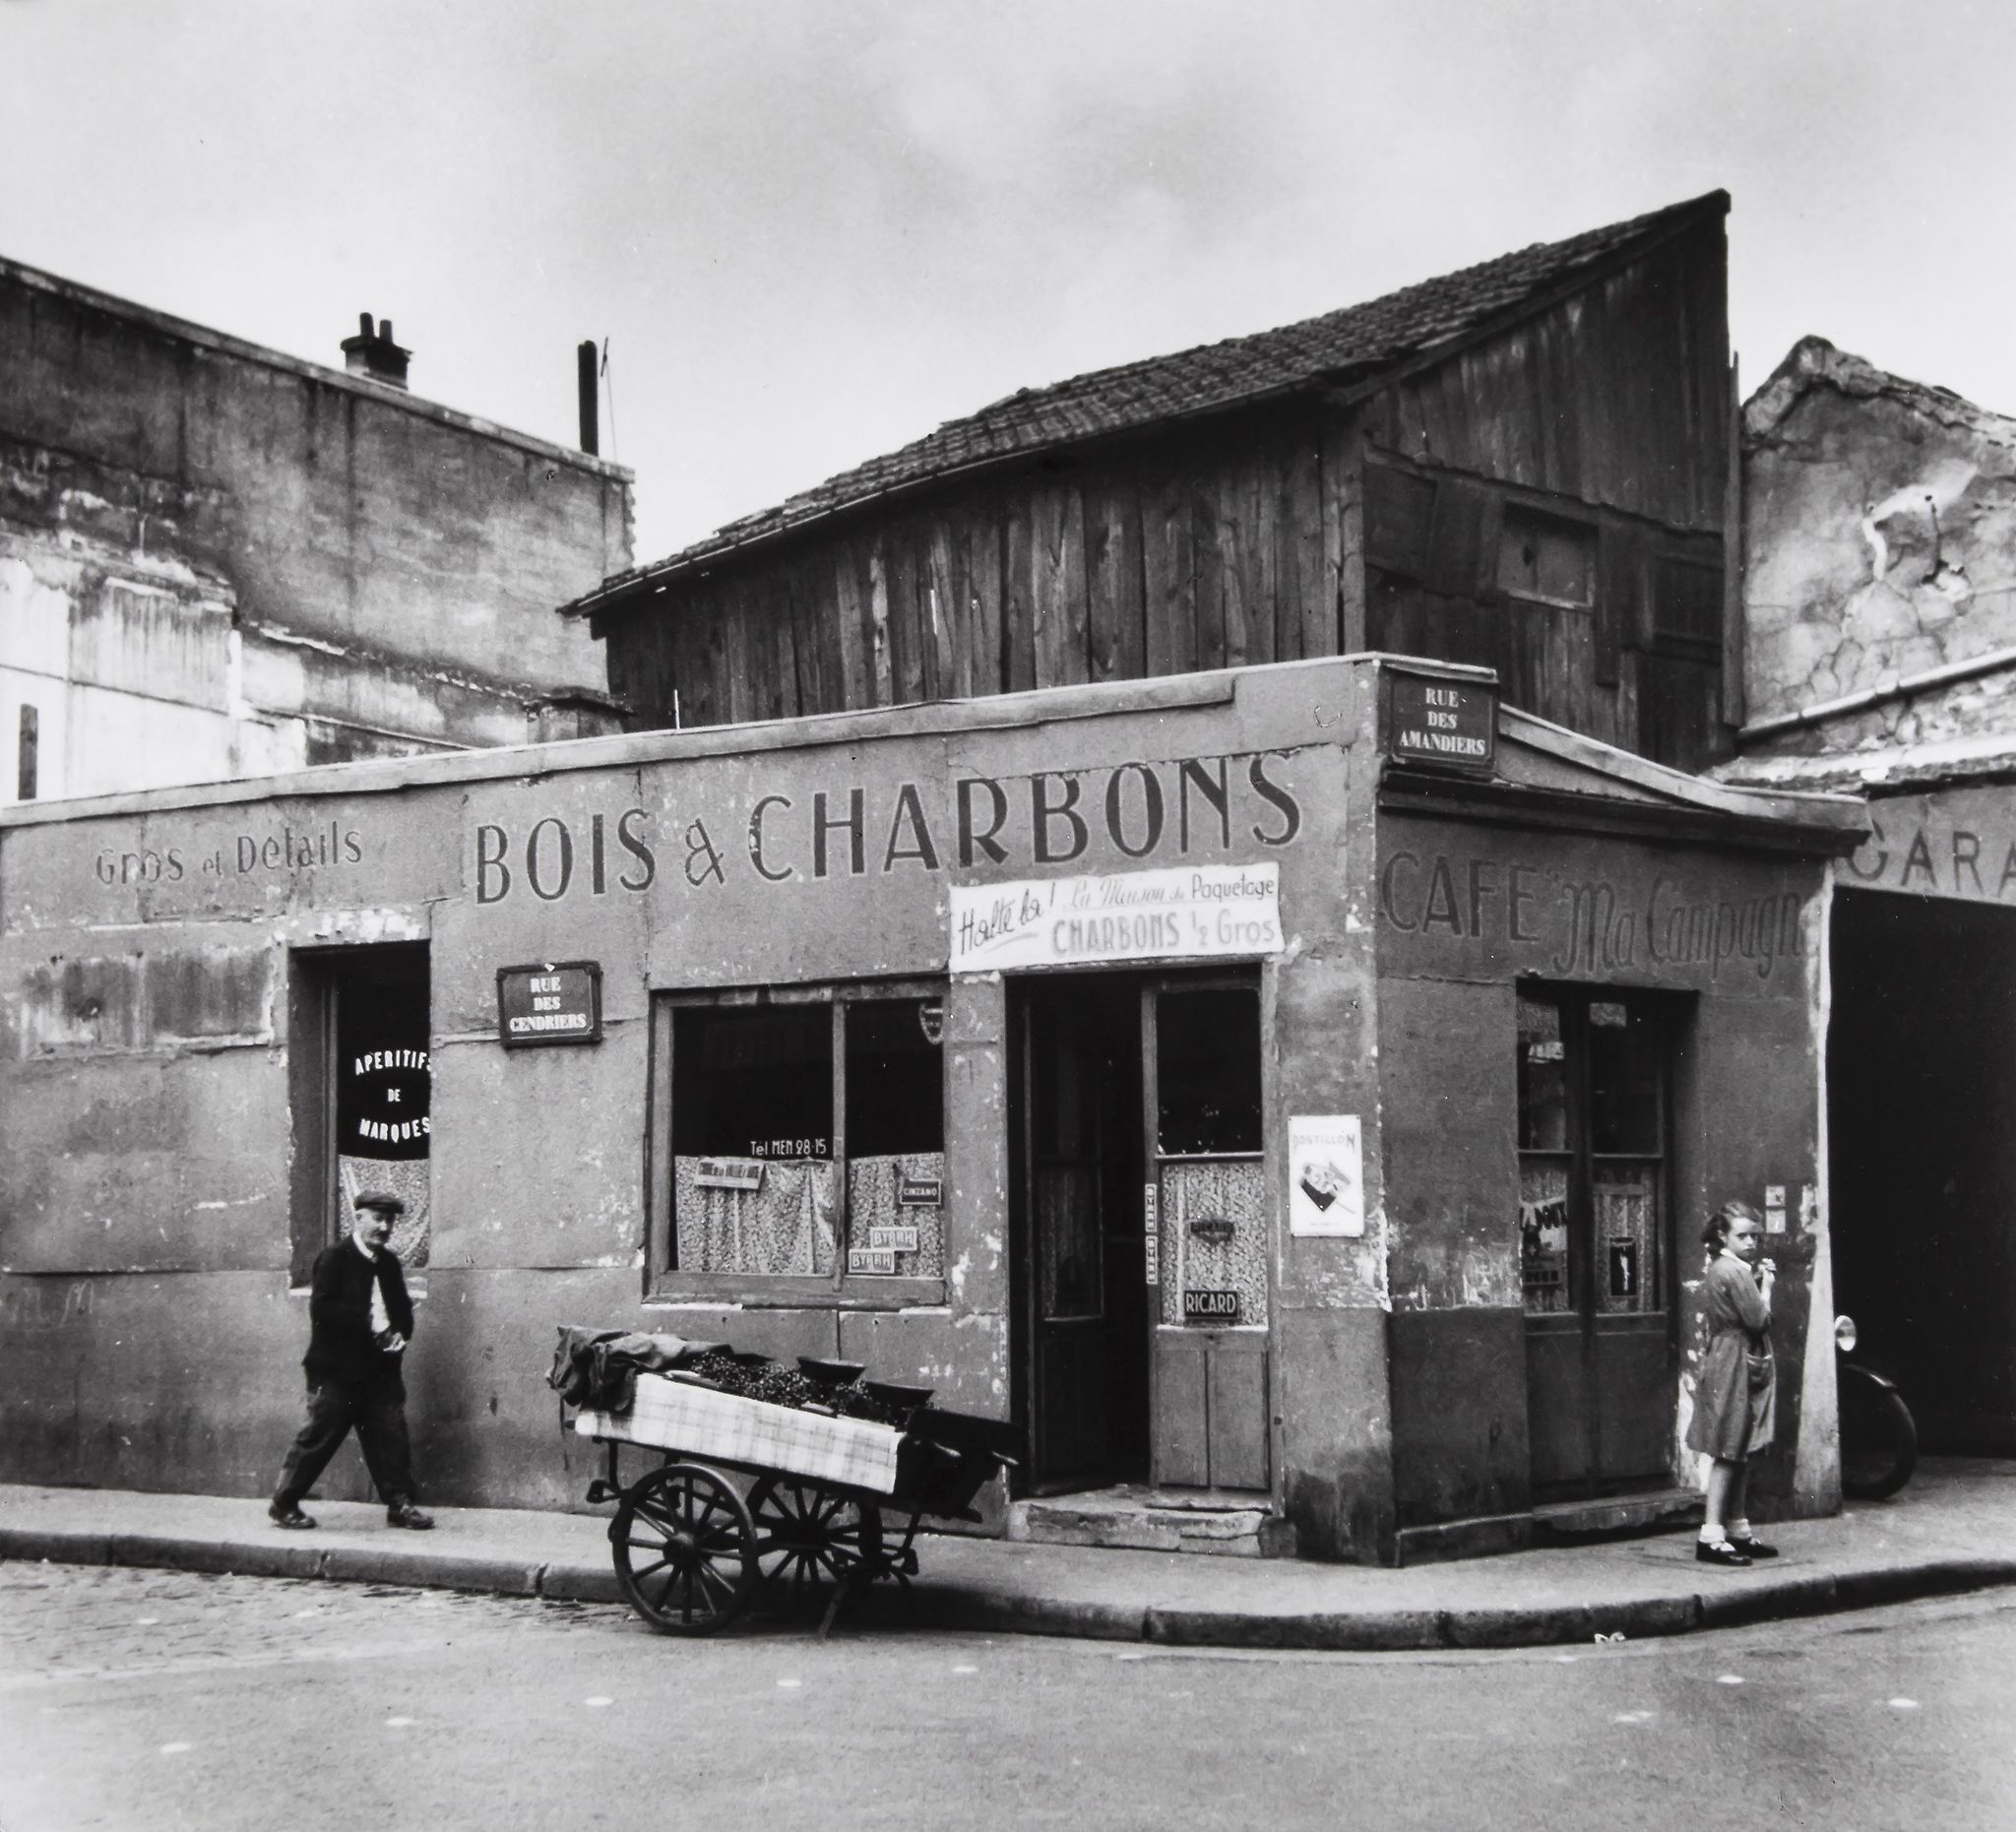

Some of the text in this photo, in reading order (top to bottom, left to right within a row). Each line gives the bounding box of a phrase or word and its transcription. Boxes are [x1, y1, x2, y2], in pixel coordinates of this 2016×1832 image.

[1425, 687, 1459, 708] RUE
[1426, 711, 1458, 729] DES
[1399, 729, 1486, 756] AMANDIERS
[476, 751, 1301, 905] BOIS & CHARBONS
[95, 848, 185, 886] Gros
[1191, 873, 1276, 904] Paquetage
[958, 897, 1016, 956] Halte
[1381, 850, 1542, 942] CAFE
[1646, 874, 1808, 979] Campagn
[1051, 912, 1180, 957] CHARBONS
[1216, 908, 1276, 946] Gros
[530, 976, 562, 993] RUE
[533, 995, 562, 1012] DES
[509, 1013, 588, 1033] CENDRIERS
[387, 1088, 402, 1103] DE
[358, 1115, 431, 1144] MARQUES
[771, 1139, 793, 1156] MEN
[1185, 1293, 1237, 1313] RICARD
